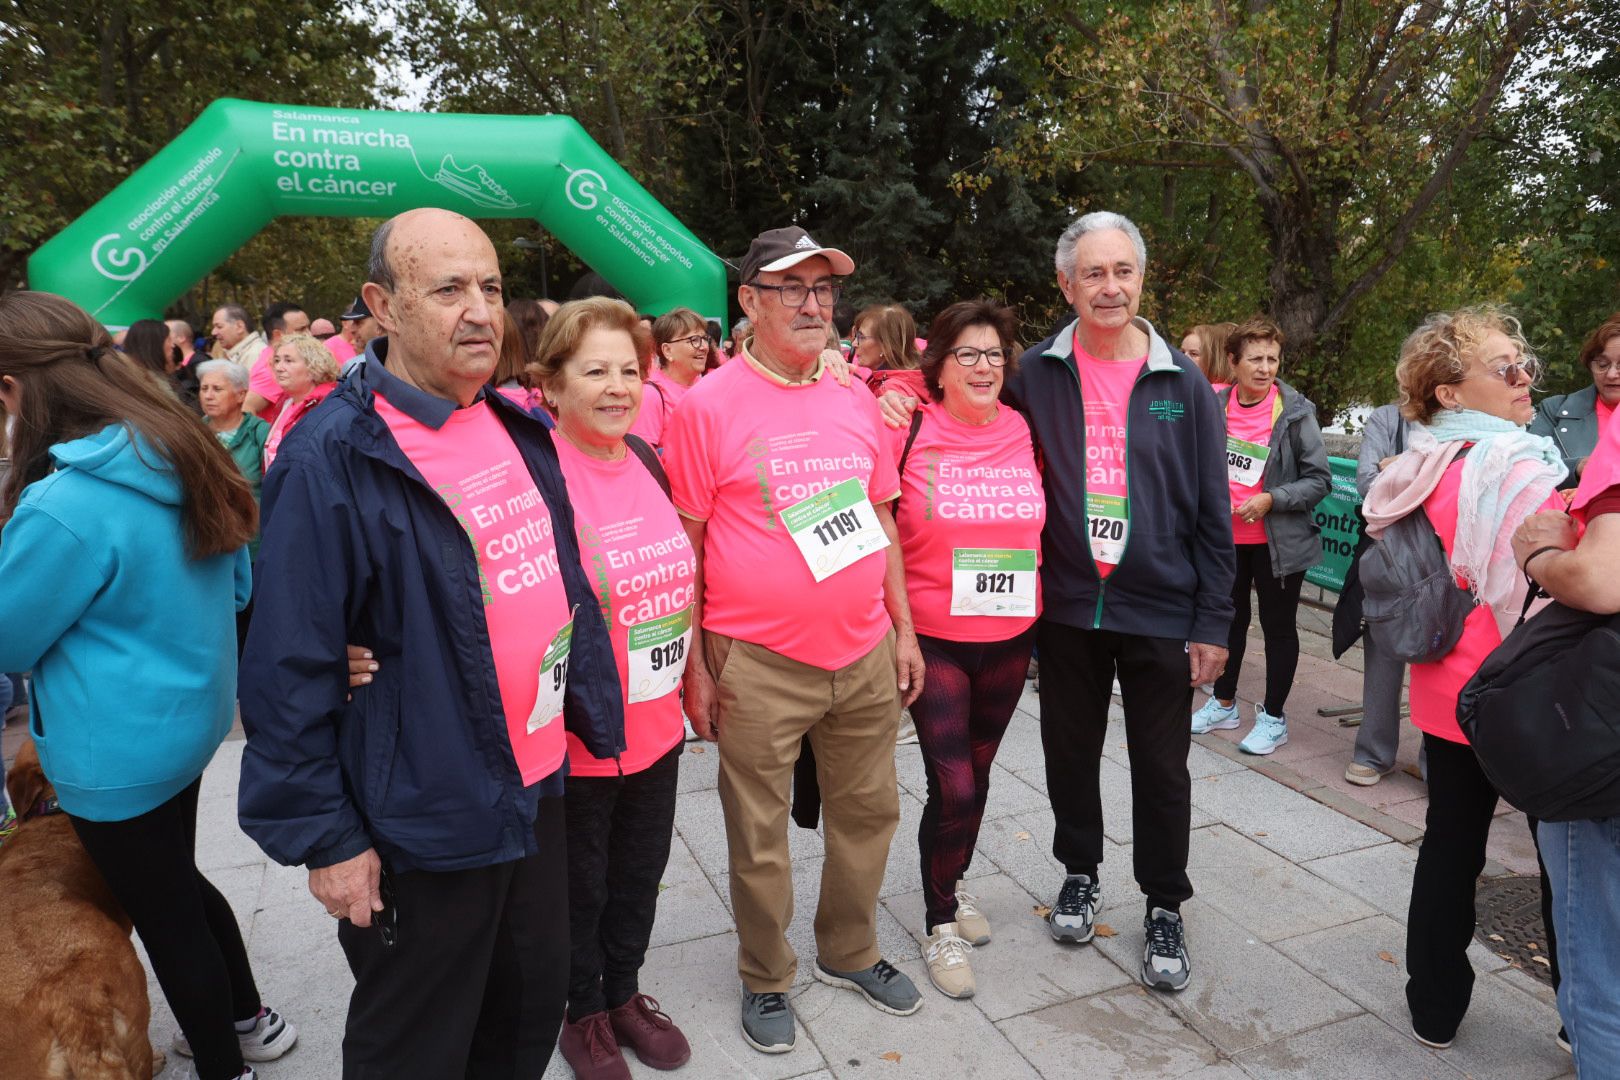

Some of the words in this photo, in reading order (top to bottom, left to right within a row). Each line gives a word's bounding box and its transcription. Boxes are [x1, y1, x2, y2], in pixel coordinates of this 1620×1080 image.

[272, 110, 360, 124] Salamanca
[272, 122, 306, 142] En
[312, 128, 412, 148] marcha
[273, 149, 360, 171] contra
[128, 184, 180, 231] asociación
[178, 147, 223, 188] española
[277, 172, 303, 192] el
[307, 174, 397, 196] cáncer
[140, 210, 173, 241] contra
[171, 200, 184, 214] el
[181, 174, 215, 206] cáncer
[152, 238, 168, 252] en
[164, 192, 220, 241] Salamanca
[604, 206, 633, 232] contra
[632, 228, 644, 239] el
[641, 237, 671, 263] cáncer
[612, 196, 657, 237] asociación
[656, 235, 694, 269] española
[596, 215, 609, 227] en
[608, 223, 655, 267] Salamanca
[771, 458, 799, 476] En
[803, 452, 872, 472] marcha
[939, 462, 962, 478] En
[967, 466, 1033, 479] marcha
[938, 482, 1015, 497] contra
[1016, 480, 1039, 497] el
[470, 504, 505, 529] En
[938, 498, 1042, 520] cáncer
[485, 518, 551, 561] contra
[813, 509, 862, 546] 11191
[1087, 517, 1124, 541] 120
[606, 549, 635, 569] En
[616, 556, 689, 597] contra
[976, 573, 1015, 593] 8121
[651, 637, 685, 671] 9128
